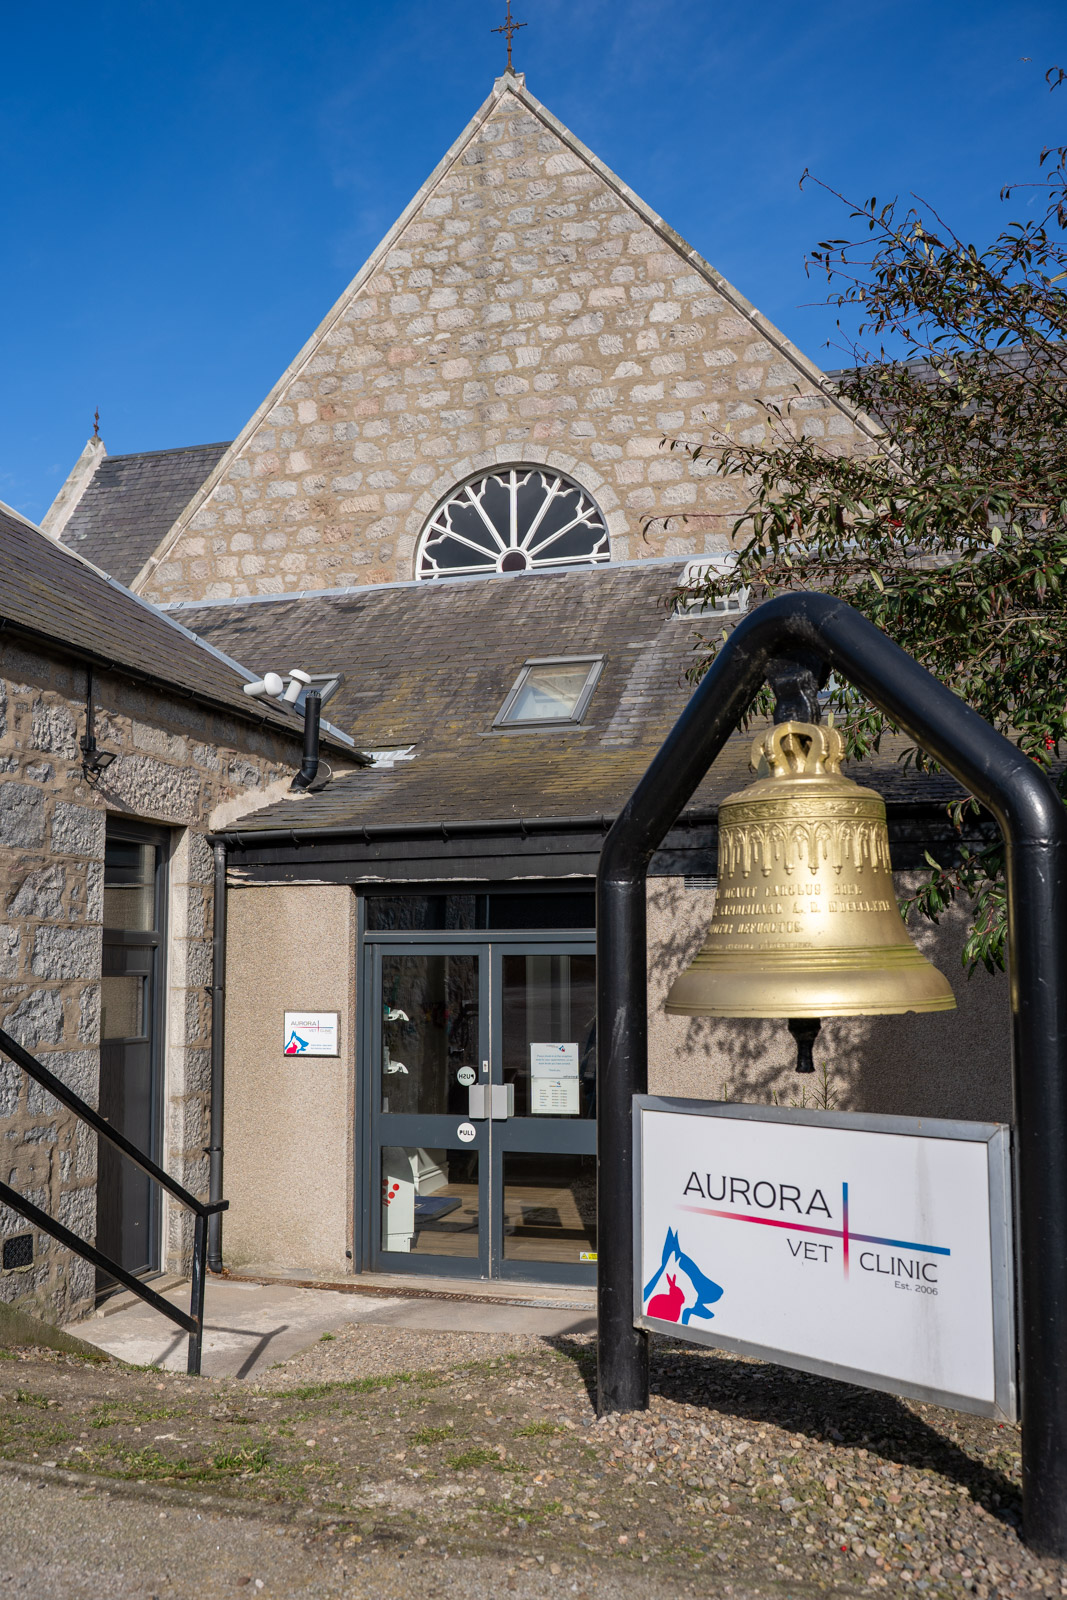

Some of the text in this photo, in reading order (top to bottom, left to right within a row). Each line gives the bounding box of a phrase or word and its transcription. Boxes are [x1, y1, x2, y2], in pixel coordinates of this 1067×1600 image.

[682, 1171, 833, 1219] AURORA
[786, 1238, 938, 1283] VET CLINIC
[894, 1280, 939, 1296] Est. 2006
